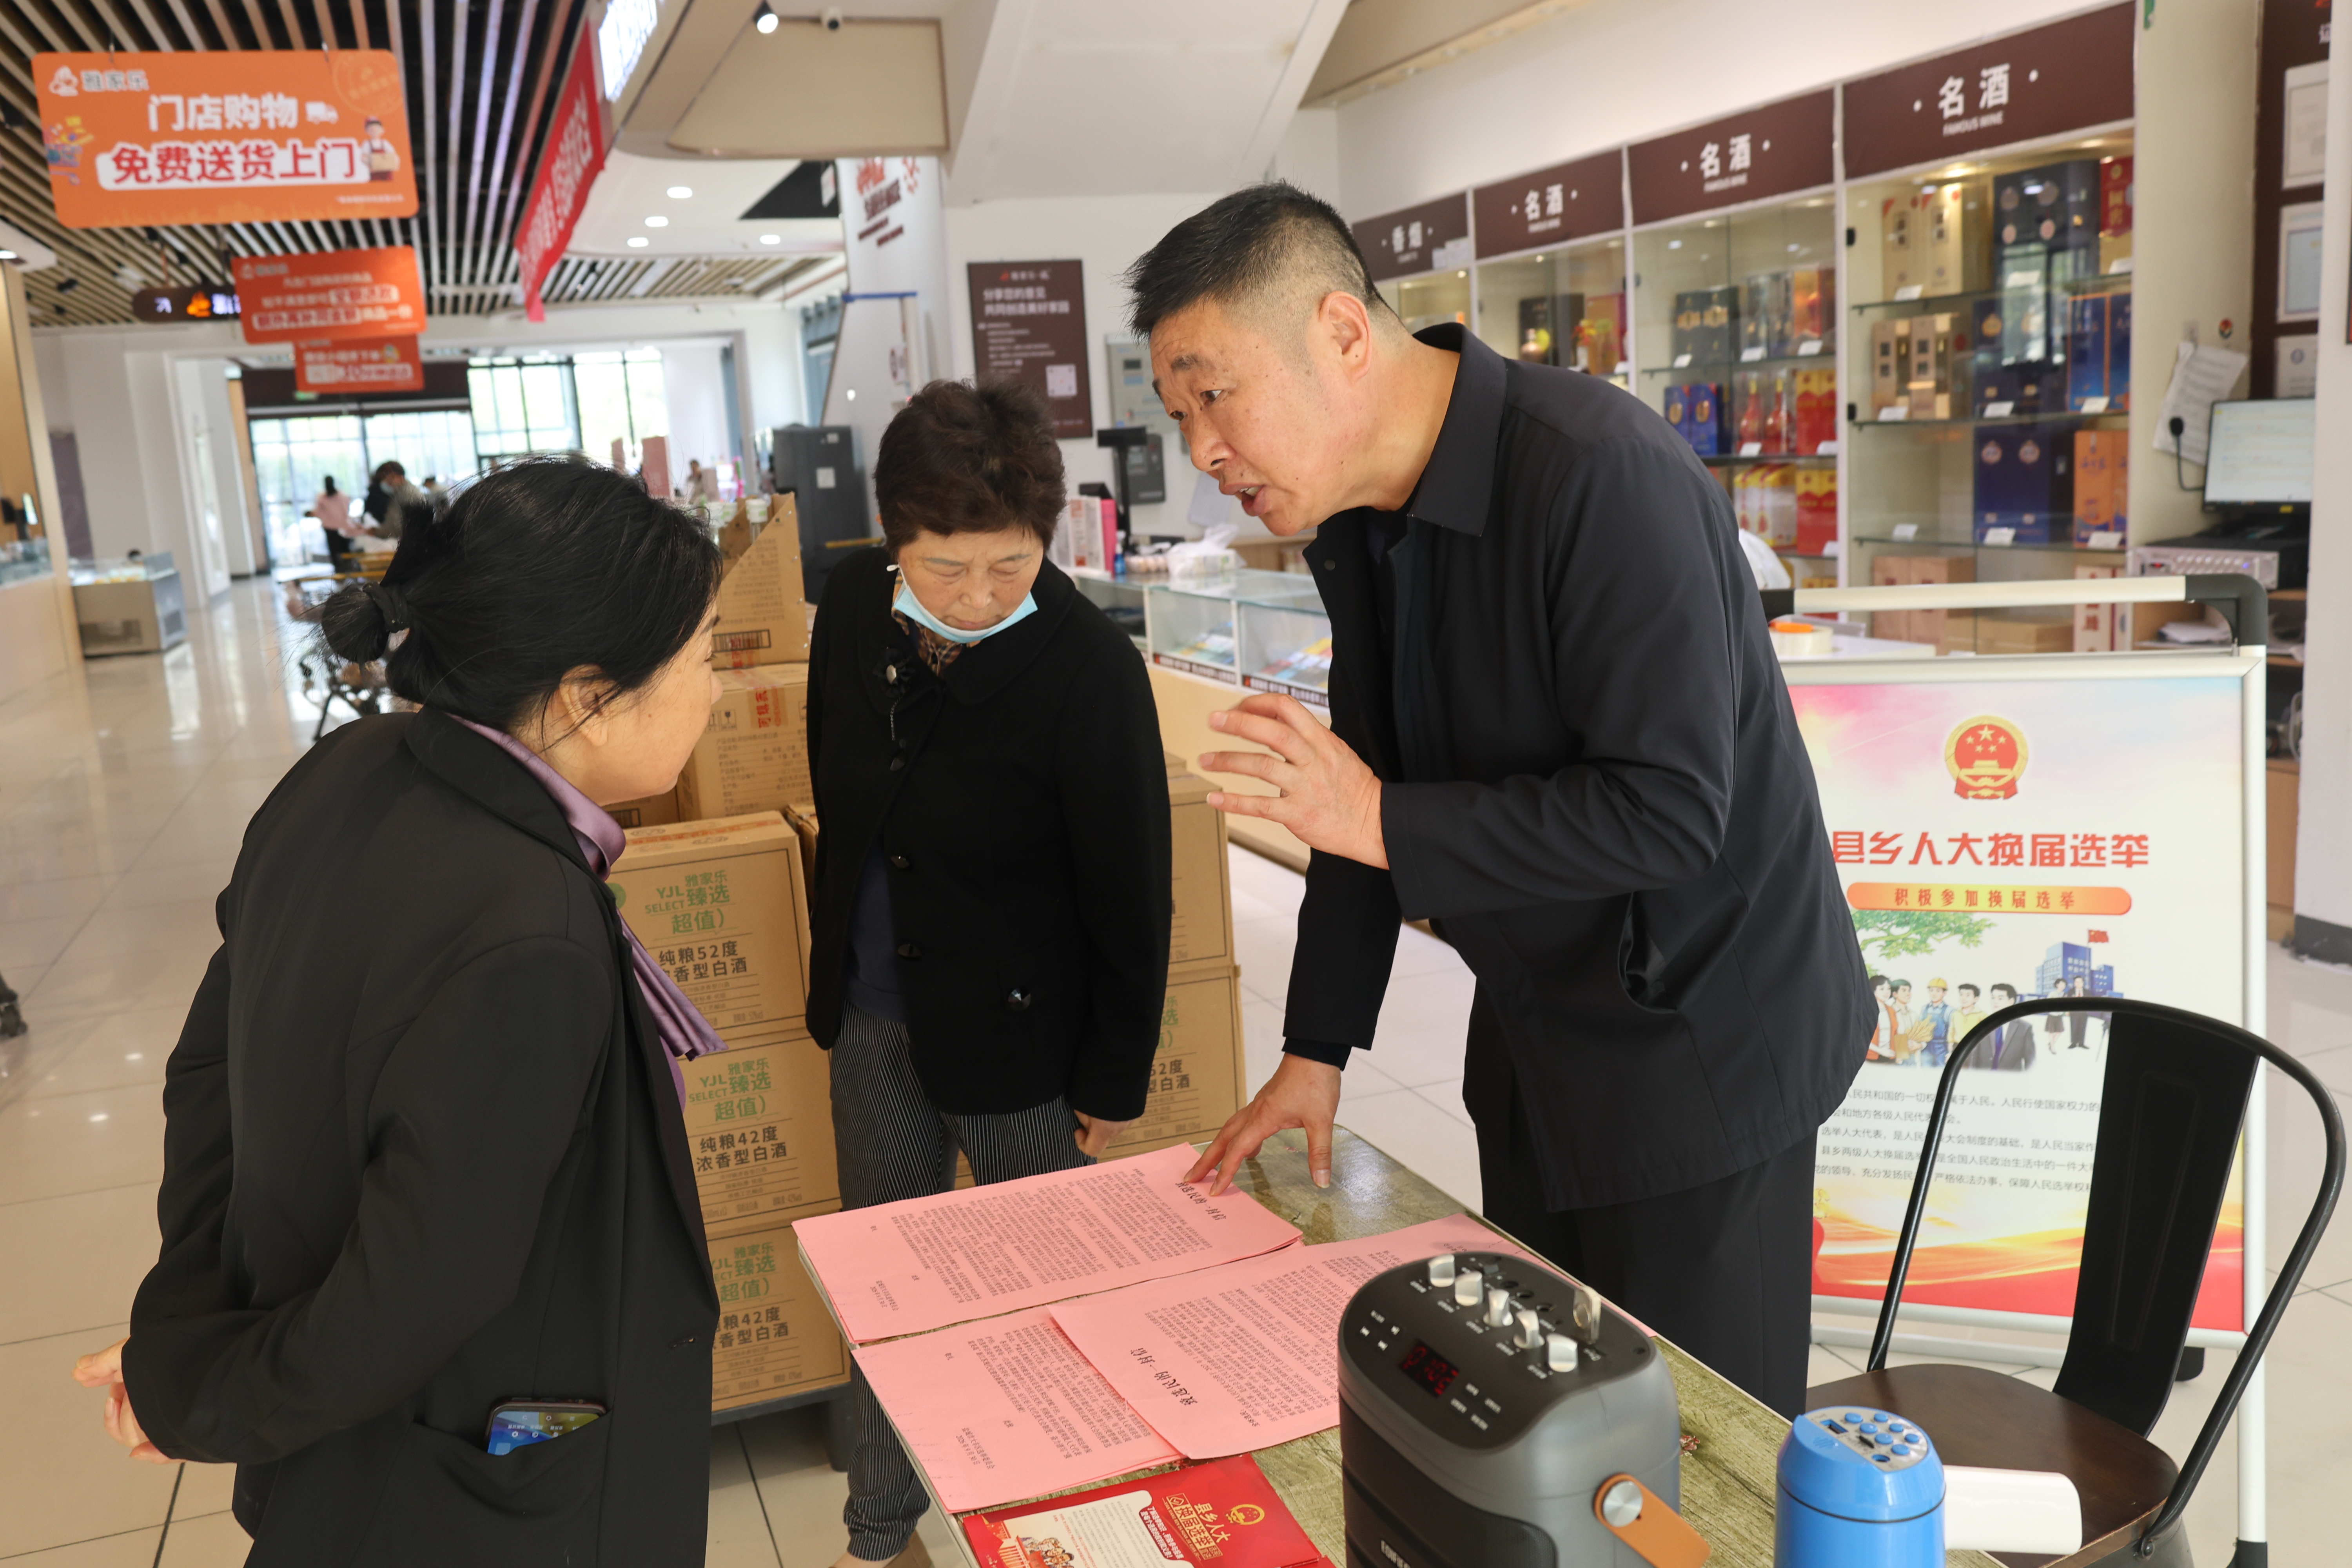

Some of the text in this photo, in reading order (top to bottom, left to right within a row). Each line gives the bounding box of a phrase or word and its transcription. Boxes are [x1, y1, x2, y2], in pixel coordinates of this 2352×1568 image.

[1938, 63, 2011, 120] 名酒
[148, 94, 298, 132] 门店购物
[111, 141, 358, 185] 免费送货上门
[1700, 134, 1751, 179] 名酒
[1524, 183, 1564, 221] 名酒
[1832, 831, 2149, 867] 县乡人大换届选举
[684, 870, 728, 887] 雅家乐
[656, 886, 684, 898] YJL
[686, 884, 730, 907] 臻选
[1894, 887, 2074, 909] 积极参加换届选举
[645, 900, 684, 914] SELECT
[659, 940, 738, 966] 纯粮52度
[728, 1057, 769, 1075] 雅家乐
[700, 1074, 727, 1088] YJL
[728, 1071, 771, 1094] 臻选
[689, 1087, 727, 1102] SELECT
[1848, 1089, 2099, 1112] 民共和国的一切权属于人民。人民行使国家权力的
[700, 1126, 778, 1152] 纯粮42度
[697, 1142, 786, 1172] 浓香型白酒
[734, 1241, 774, 1259] 雅家乐
[735, 1256, 775, 1278] 臻选
[713, 1322, 788, 1349] 香型白酒
[1127, 1347, 1200, 1406] 致选民的一封信
[1176, 1504, 1213, 1547] 换届选举
[1194, 1503, 1231, 1543] 县乡人大
